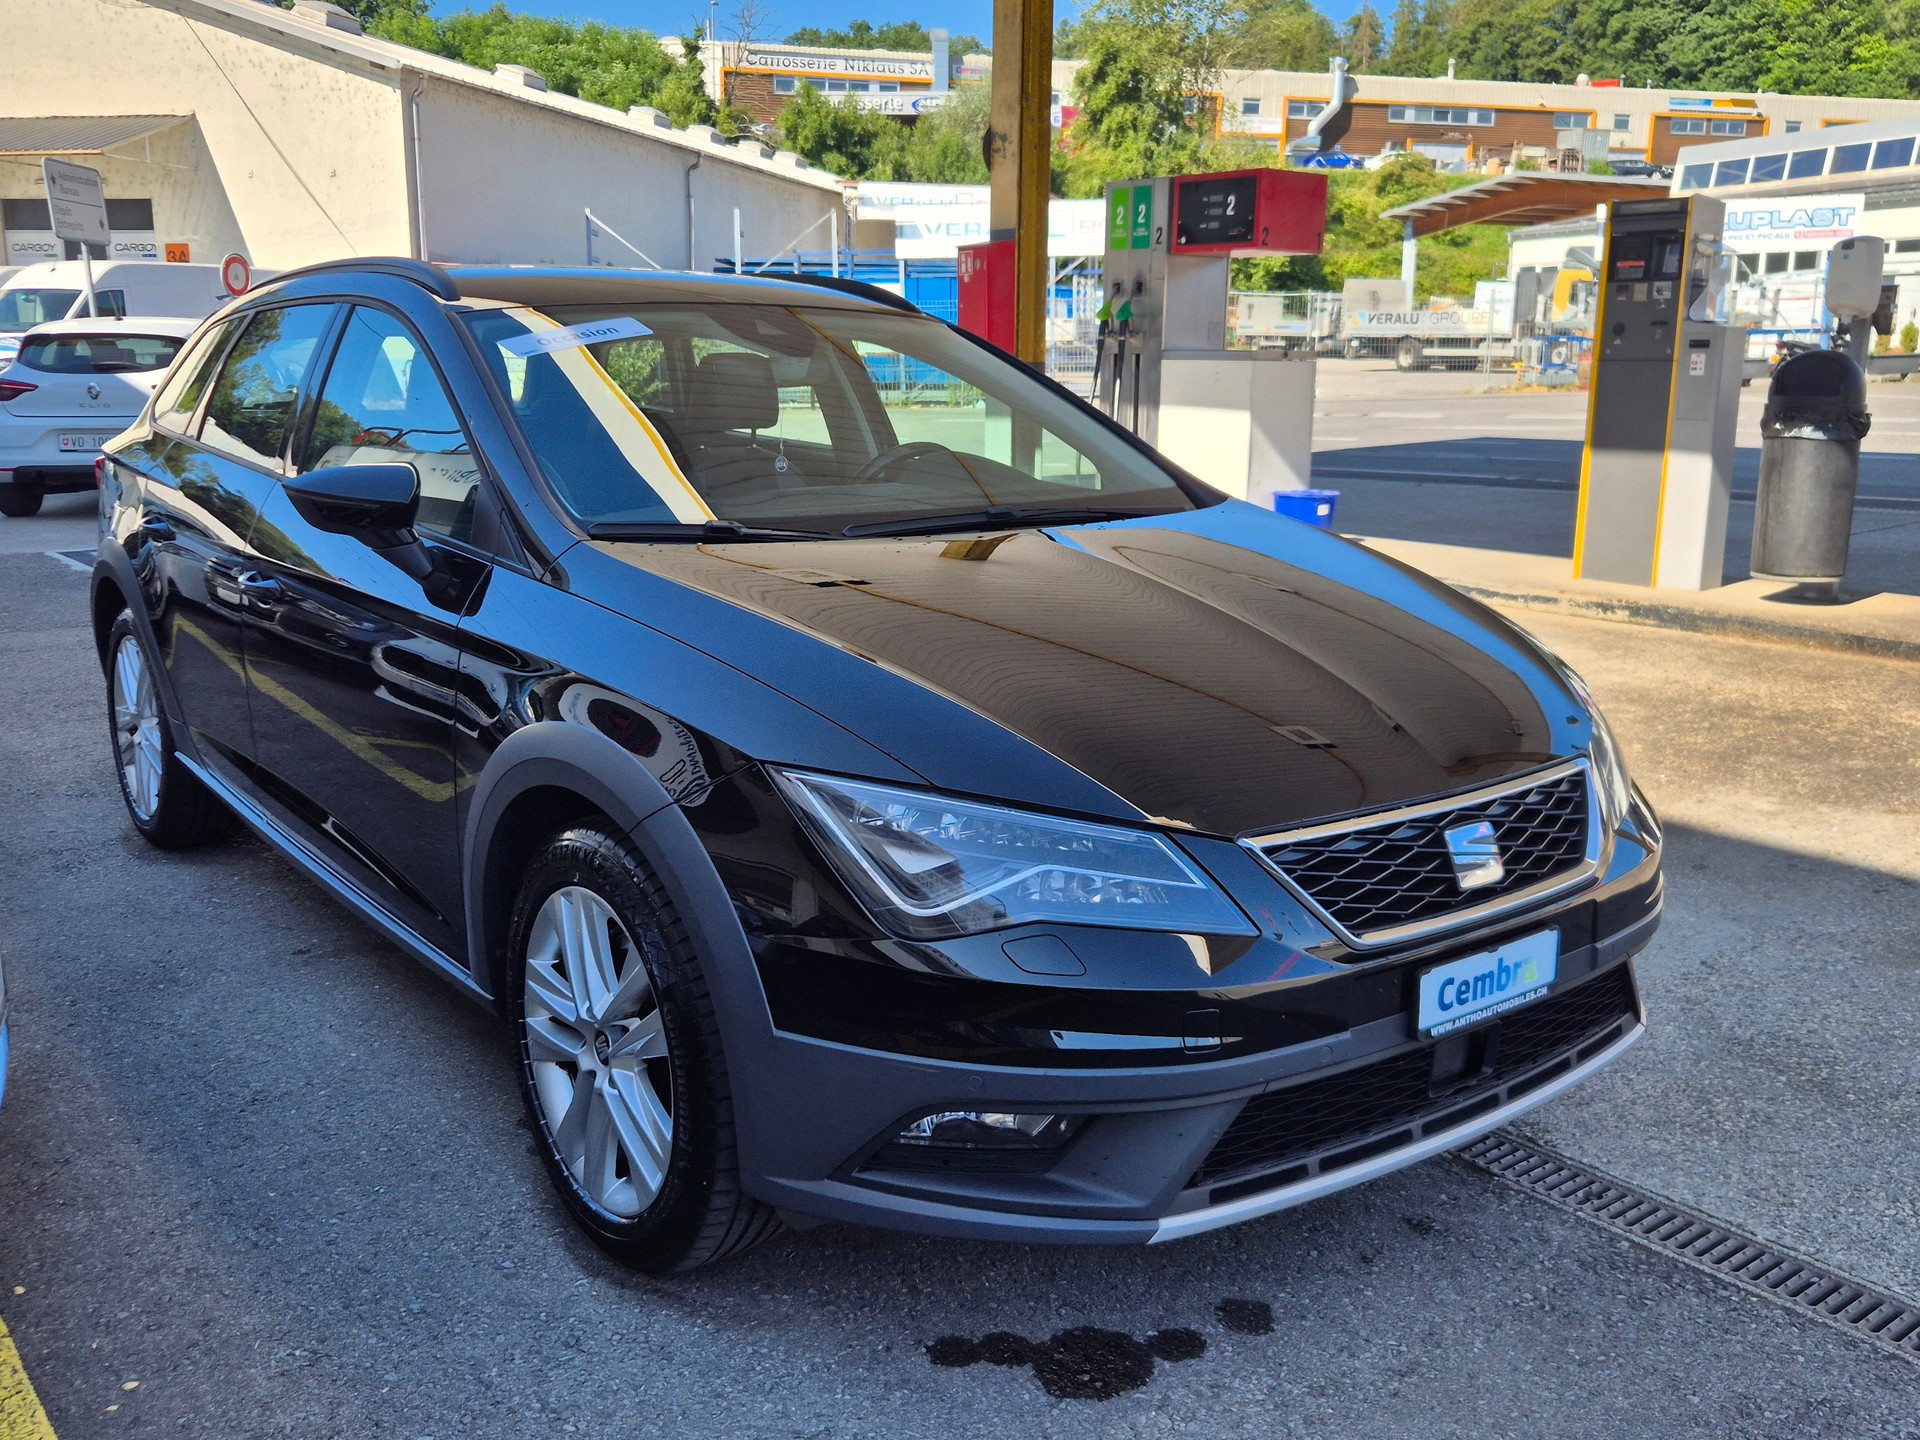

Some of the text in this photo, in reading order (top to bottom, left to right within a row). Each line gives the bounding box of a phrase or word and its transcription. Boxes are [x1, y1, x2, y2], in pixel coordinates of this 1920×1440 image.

[745, 51, 929, 76] Carrosserie Niklaus SA
[1116, 206, 1124, 225] 2
[1137, 204, 1146, 224] 2
[1226, 195, 1235, 216] 2
[1723, 206, 1856, 232] UPLAST
[1155, 227, 1163, 245] 2
[1261, 227, 1269, 246] 2
[1368, 312, 1420, 325] VERALU
[536, 326, 620, 347] Occasion
[71, 437, 85, 447] VD
[1437, 956, 1538, 1012] Cembra
[1430, 986, 1548, 1038] WWW.ANTHOAUTOMOBILES.CH
